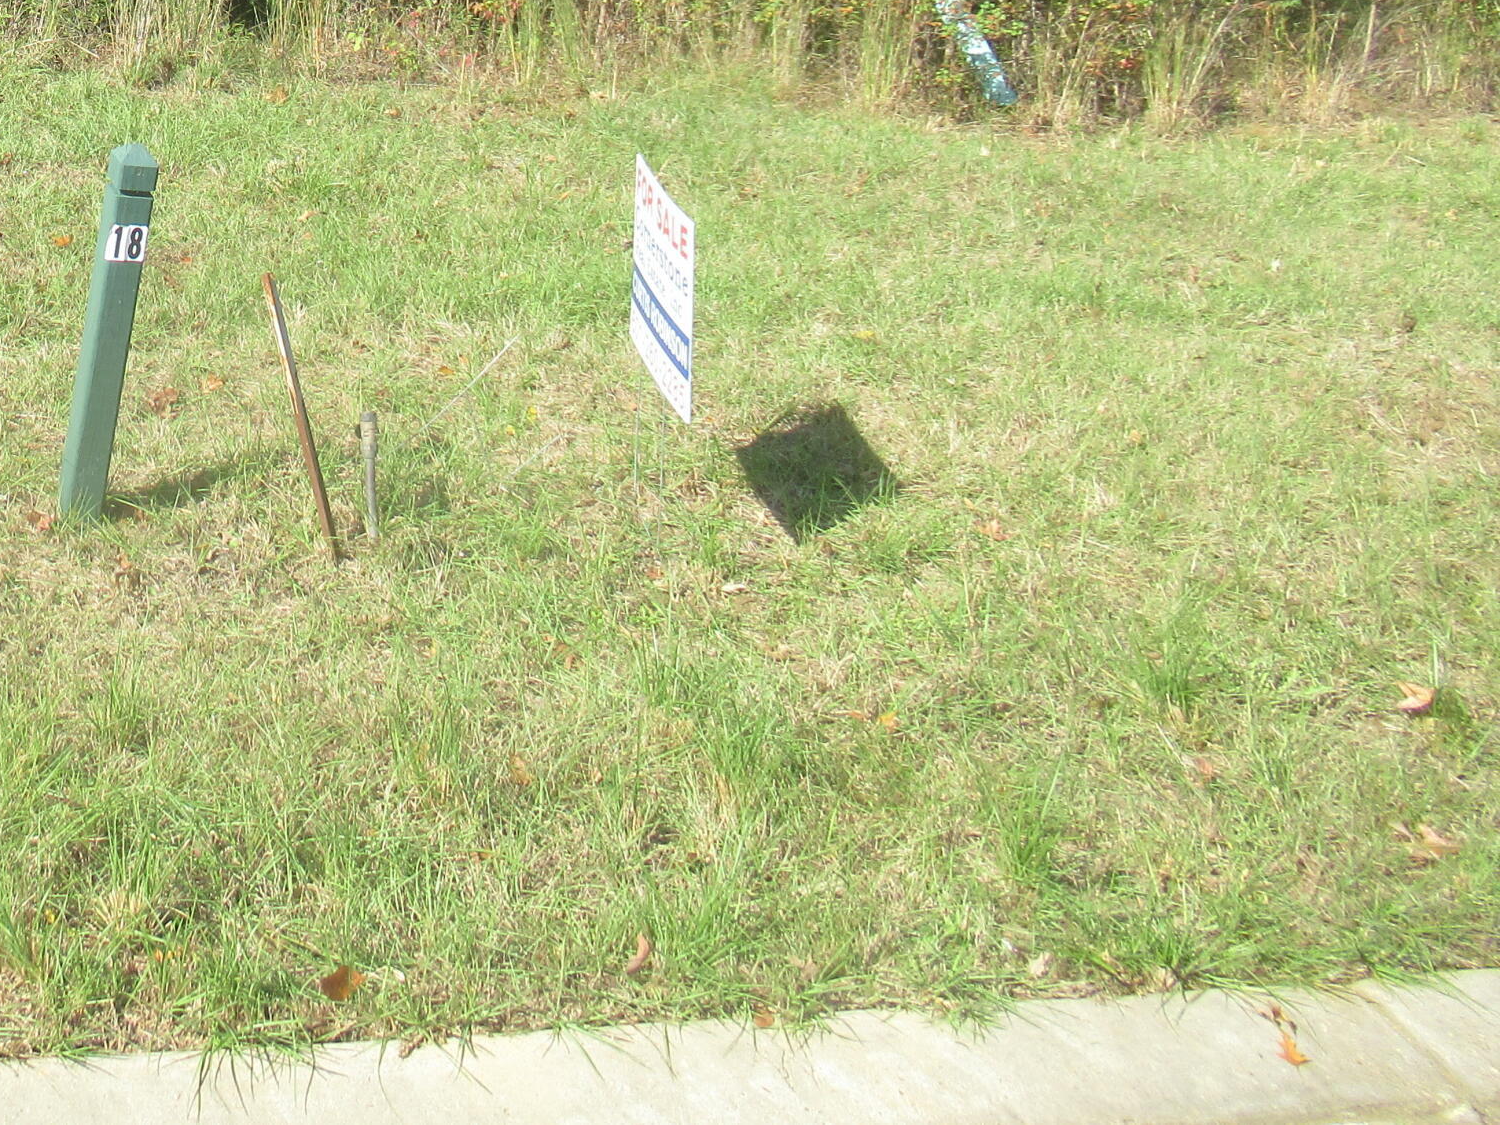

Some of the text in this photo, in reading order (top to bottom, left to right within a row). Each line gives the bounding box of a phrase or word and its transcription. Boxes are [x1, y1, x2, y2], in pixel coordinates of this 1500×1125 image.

[113, 226, 144, 259] 18
[638, 167, 654, 216] FOR
[657, 197, 689, 260] SALE
